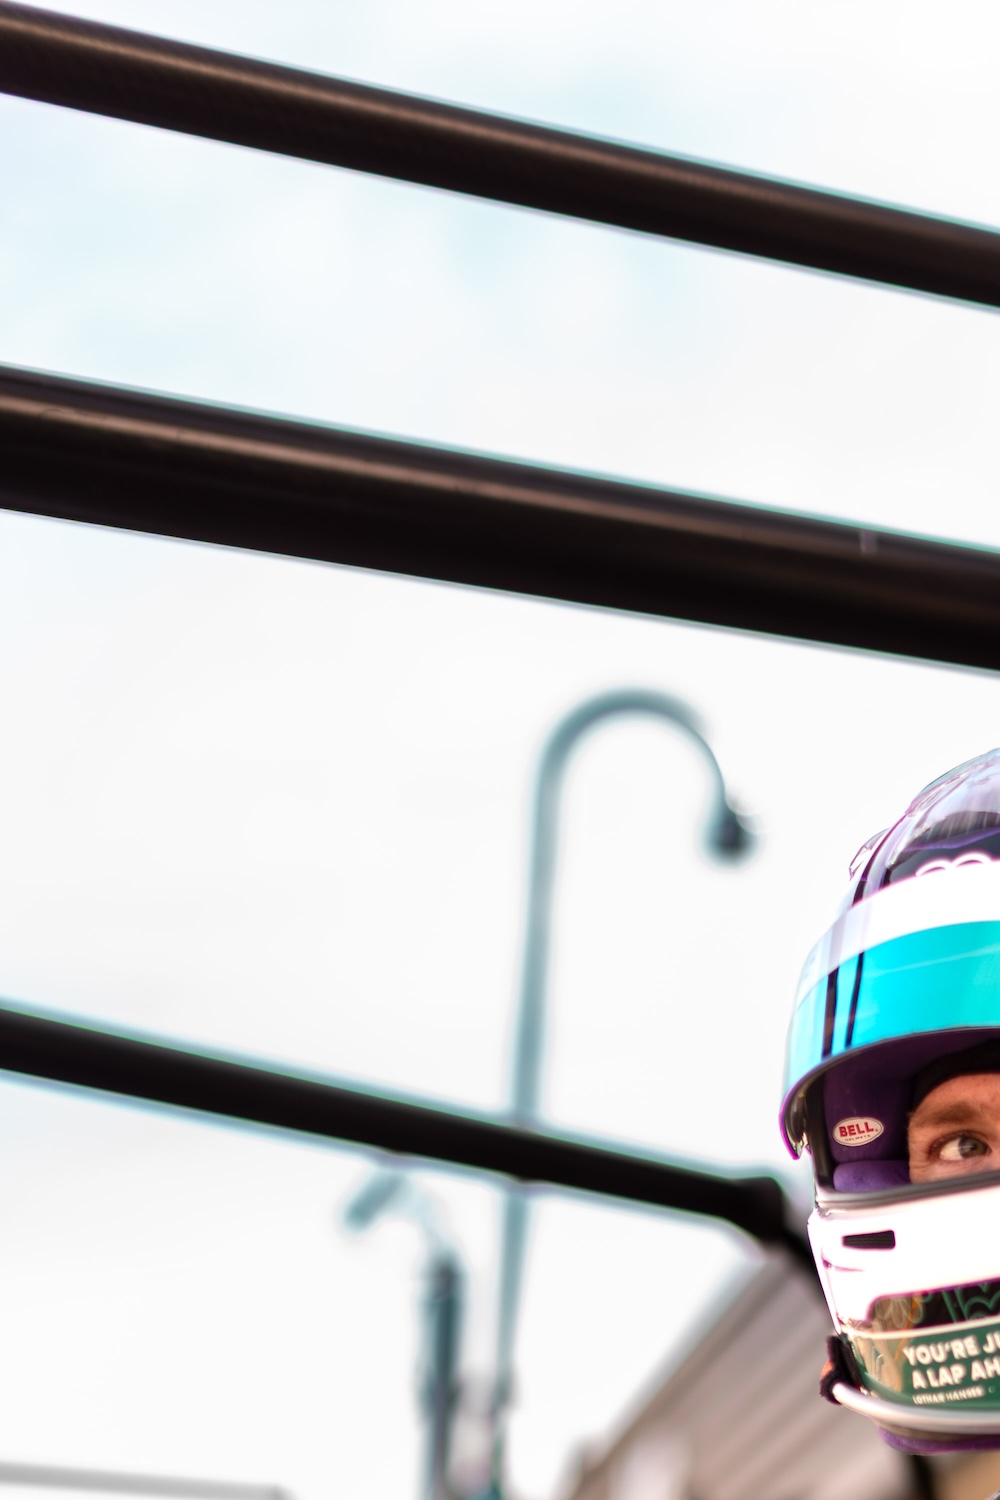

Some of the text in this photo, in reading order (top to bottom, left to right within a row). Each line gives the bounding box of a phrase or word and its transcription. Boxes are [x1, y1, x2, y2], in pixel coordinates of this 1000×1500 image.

[839, 1122, 874, 1137] BELL
[903, 1335, 980, 1366] YOU'RE
[912, 1369, 928, 1390] A
[926, 1363, 966, 1389] LAP
